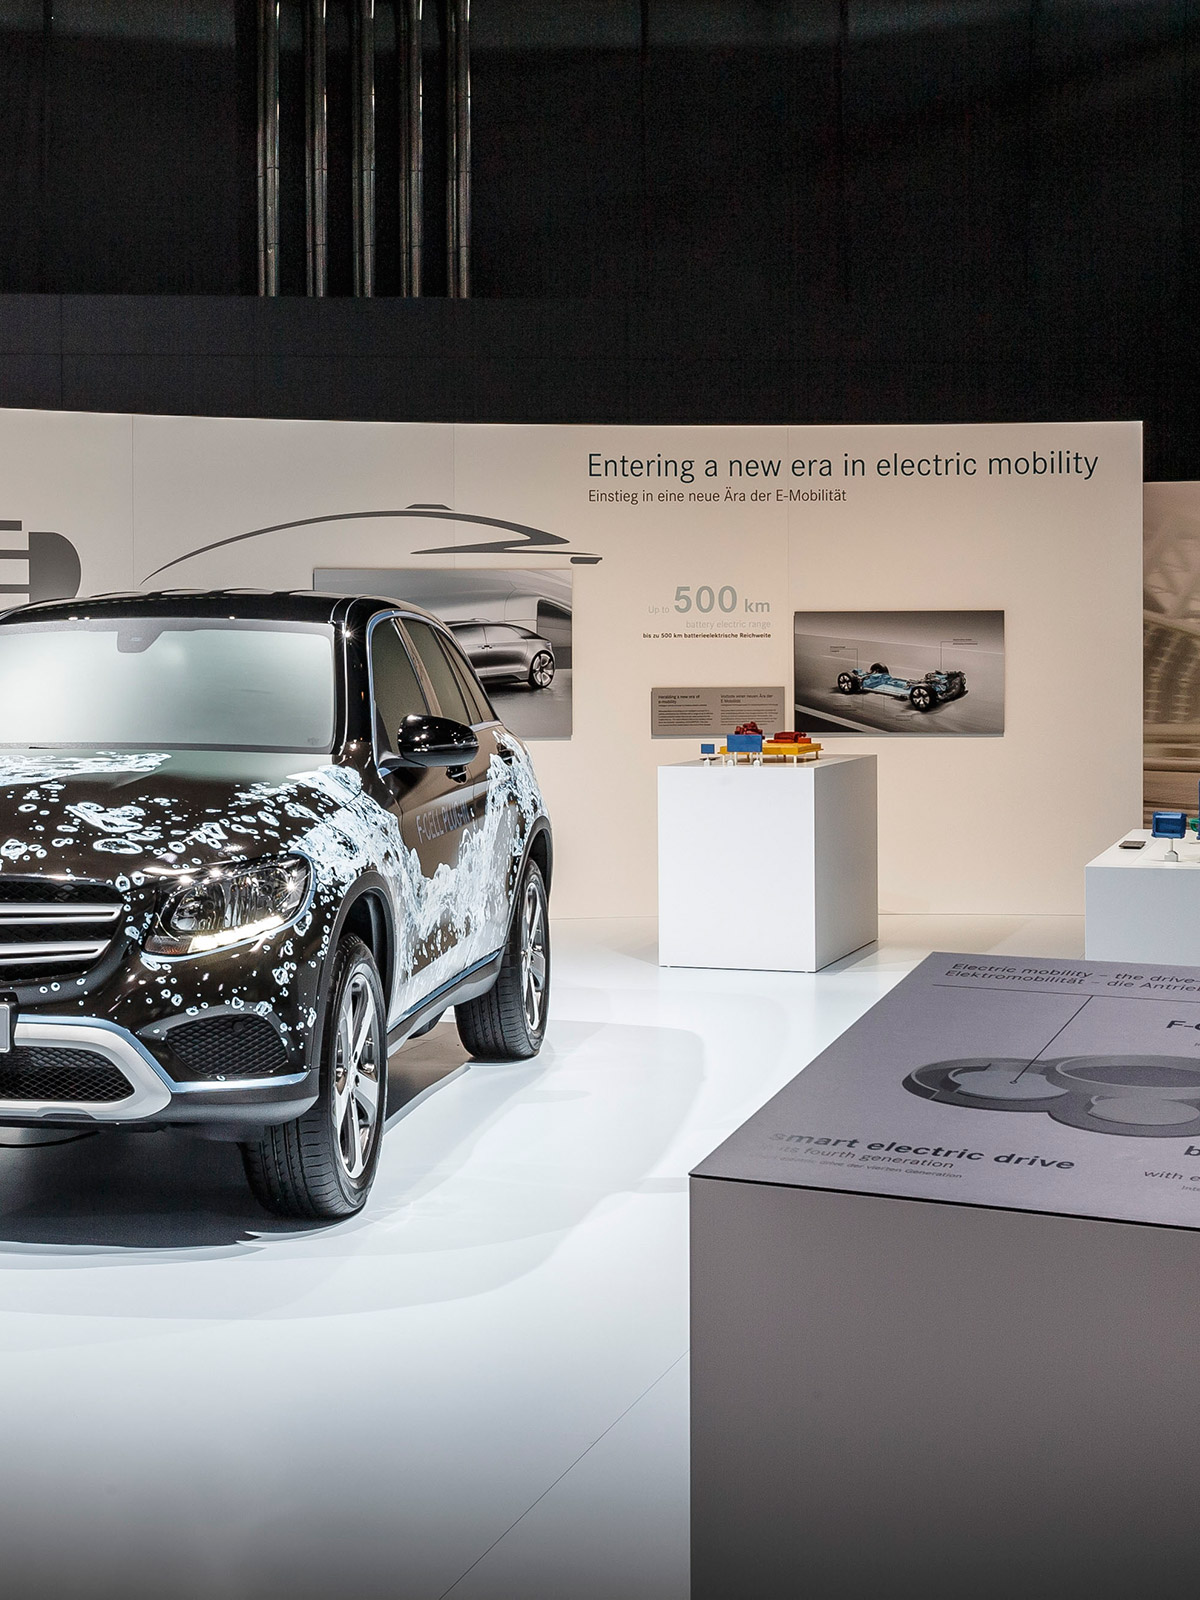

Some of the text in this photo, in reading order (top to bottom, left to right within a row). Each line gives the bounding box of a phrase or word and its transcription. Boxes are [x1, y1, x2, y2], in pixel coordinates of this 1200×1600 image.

[588, 450, 1099, 484] Entering a new era in electric mobility
[588, 486, 847, 506] Einstieg in eine neue Ära der E-Mobilität
[648, 585, 771, 615] Up to 500 km
[685, 620, 772, 630] battery electric range
[944, 969, 1085, 986] Elektromobilität
[1106, 979, 1135, 989] die
[951, 962, 1017, 975] Electric
[1020, 966, 1094, 979] mobility
[1115, 972, 1144, 982] the
[768, 1132, 1075, 1171] smart electric drive
[803, 1146, 856, 1160] fourth
[859, 1154, 955, 1170] generation
[904, 1168, 963, 1179] Generation
[1144, 1171, 1184, 1180] with
